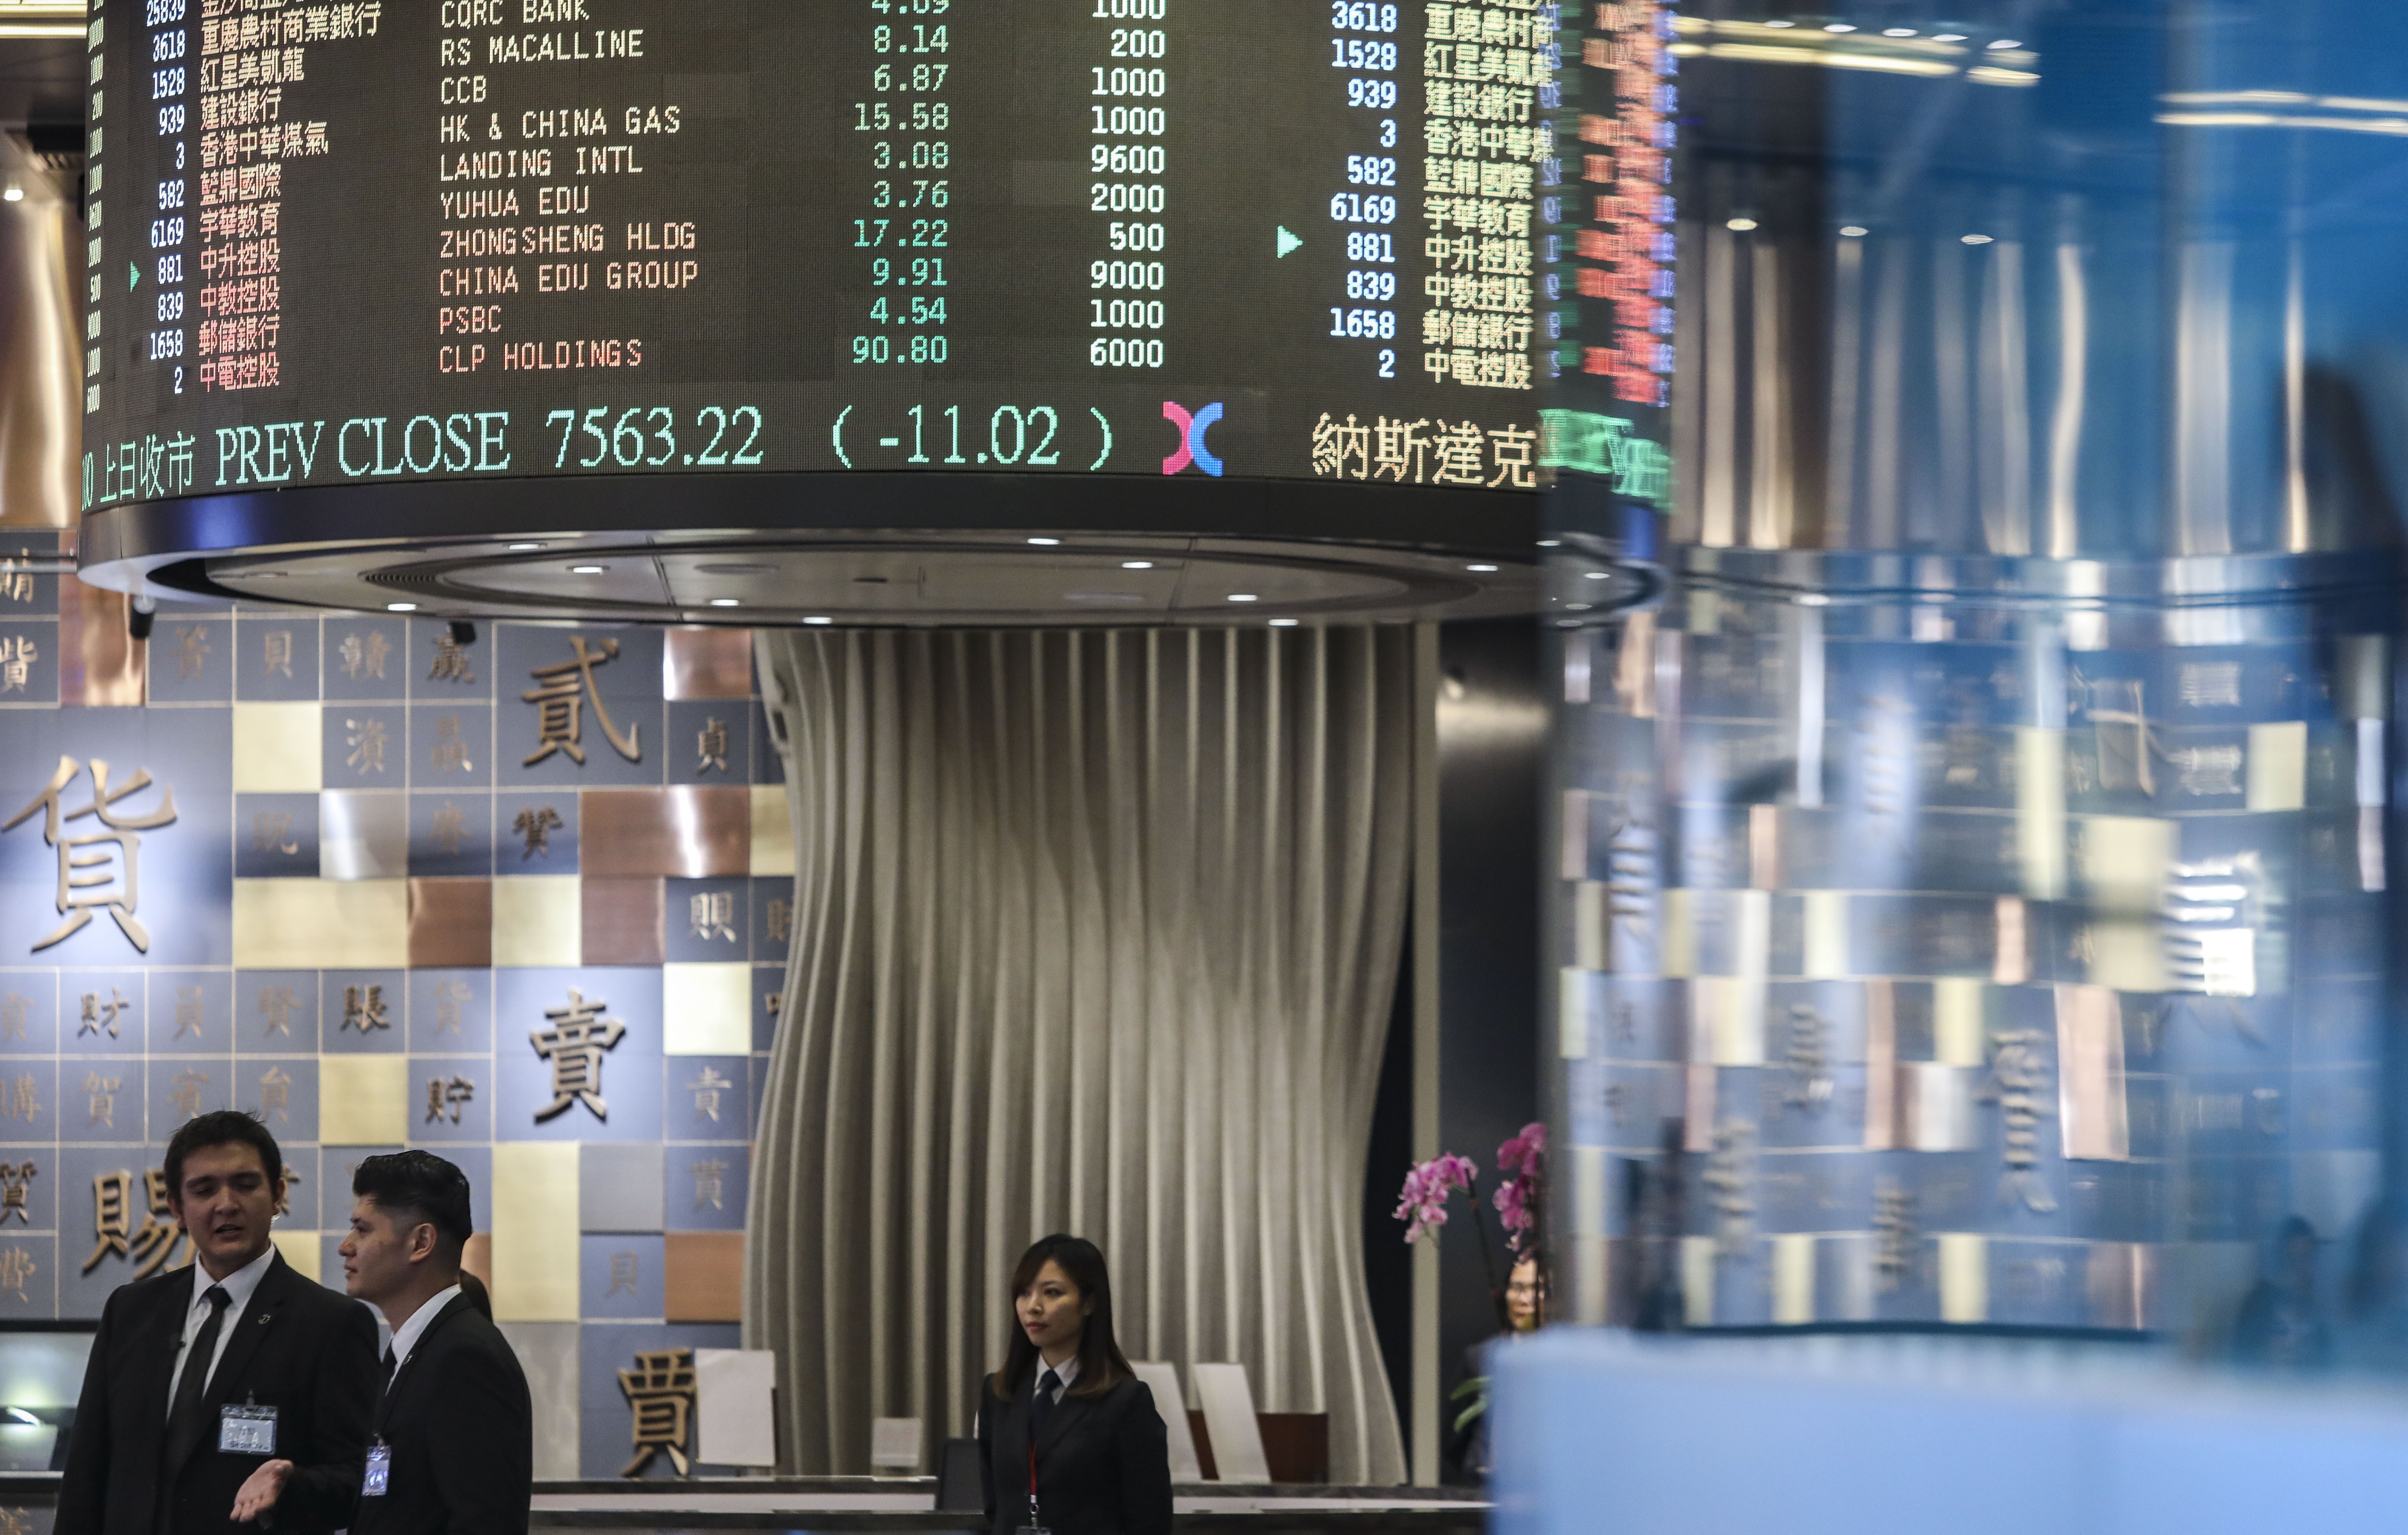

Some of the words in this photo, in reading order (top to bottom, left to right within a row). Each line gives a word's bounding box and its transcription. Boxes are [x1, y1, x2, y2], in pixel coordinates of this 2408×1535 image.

[147, 0, 186, 27] 25839
[442, 0, 503, 29] CQRC
[523, 0, 590, 23] BANK
[1092, 0, 1166, 19] 1000
[1331, 1, 1397, 33] 3618
[201, 1, 381, 55] 重慶農村商業銀行
[873, 25, 949, 53] 8.14
[1110, 29, 1166, 58] 200
[153, 29, 185, 62] 3618
[441, 37, 471, 67] RS
[489, 29, 644, 64] MACALLINE
[1331, 38, 1397, 71] 1528
[152, 66, 185, 100] 1528
[201, 47, 305, 93] 紅星美凱龍
[873, 64, 949, 91] 6.87
[1091, 67, 1165, 97] 1000
[441, 75, 487, 104] CCB
[1348, 79, 1397, 109] 939
[1424, 79, 1534, 123] 建設銀行
[159, 104, 185, 135] 939
[201, 86, 282, 131] 建設銀行
[441, 114, 470, 143] HK
[489, 112, 502, 141] &
[523, 108, 607, 139] CHINA
[625, 105, 680, 134] GAS
[855, 103, 949, 131] 15.58
[1091, 105, 1165, 136] 1000
[201, 121, 329, 167] 香港中華煤氣
[1379, 119, 1396, 148] 3
[176, 142, 185, 170] 3
[441, 148, 551, 181] LANDING
[576, 145, 643, 175] INTL
[873, 141, 949, 169] 3.08
[1091, 144, 1165, 174] 9600
[1347, 155, 1396, 186] 582
[201, 163, 281, 206] 藍鼎國際
[1424, 156, 1533, 200] 藍鼎國際
[159, 179, 184, 210] 582
[441, 189, 519, 220] YUHUA
[539, 185, 589, 215] EDU
[873, 180, 948, 208] 3.76
[1091, 183, 1165, 213] 2000
[1330, 193, 1396, 224] 6169
[151, 217, 184, 248] 6169
[440, 224, 604, 258] ZHONGSHENG
[627, 222, 695, 250] HLDG
[854, 219, 948, 247] 17.22
[1110, 222, 1164, 251] 500
[1347, 232, 1395, 263] 881
[158, 255, 183, 283] 881
[201, 238, 280, 280] 中升控股
[1425, 233, 1533, 276] 中升控股
[439, 266, 519, 296] CHINA
[539, 262, 588, 293] EDU
[607, 260, 698, 290] GROUP
[873, 258, 947, 285] 9.91
[1091, 260, 1164, 290] 9000
[1347, 271, 1395, 301] 839
[158, 291, 183, 321] 839
[201, 275, 280, 317] 中教控股
[1425, 271, 1534, 313] 中教控股
[439, 305, 502, 334] PSBC
[870, 297, 947, 324] 4.54
[1090, 299, 1164, 329] 1000
[1330, 308, 1395, 339] 1658
[151, 329, 183, 360] 1658
[199, 313, 279, 356] 郵儲銀行
[1423, 309, 1533, 351] 郵儲銀行
[439, 344, 485, 373] CLP
[504, 339, 642, 371] HOLDINGS
[853, 335, 947, 363] 90.80
[1090, 338, 1163, 368] 6000
[1379, 350, 1395, 378] 2
[175, 366, 183, 394] 2
[200, 352, 280, 392] 中電控股
[1424, 348, 1533, 390] 中電控股
[100, 431, 195, 503] 上日收市
[216, 421, 324, 485] PREV
[339, 411, 510, 476] CLOSE
[546, 406, 763, 468] 7563.22
[833, 405, 852, 469] (
[880, 404, 1060, 465] -11.02
[1090, 407, 1112, 471] )
[1312, 413, 1538, 489] 納斯達克
[522, 635, 642, 766] 貳
[698, 717, 728, 774] 貞
[1, 755, 178, 955] 貨
[78, 987, 130, 1040] 財
[529, 985, 627, 1125] 賣
[82, 1070, 122, 1130] 賀
[425, 1075, 475, 1125] 貯
[617, 1346, 698, 1478] 買
